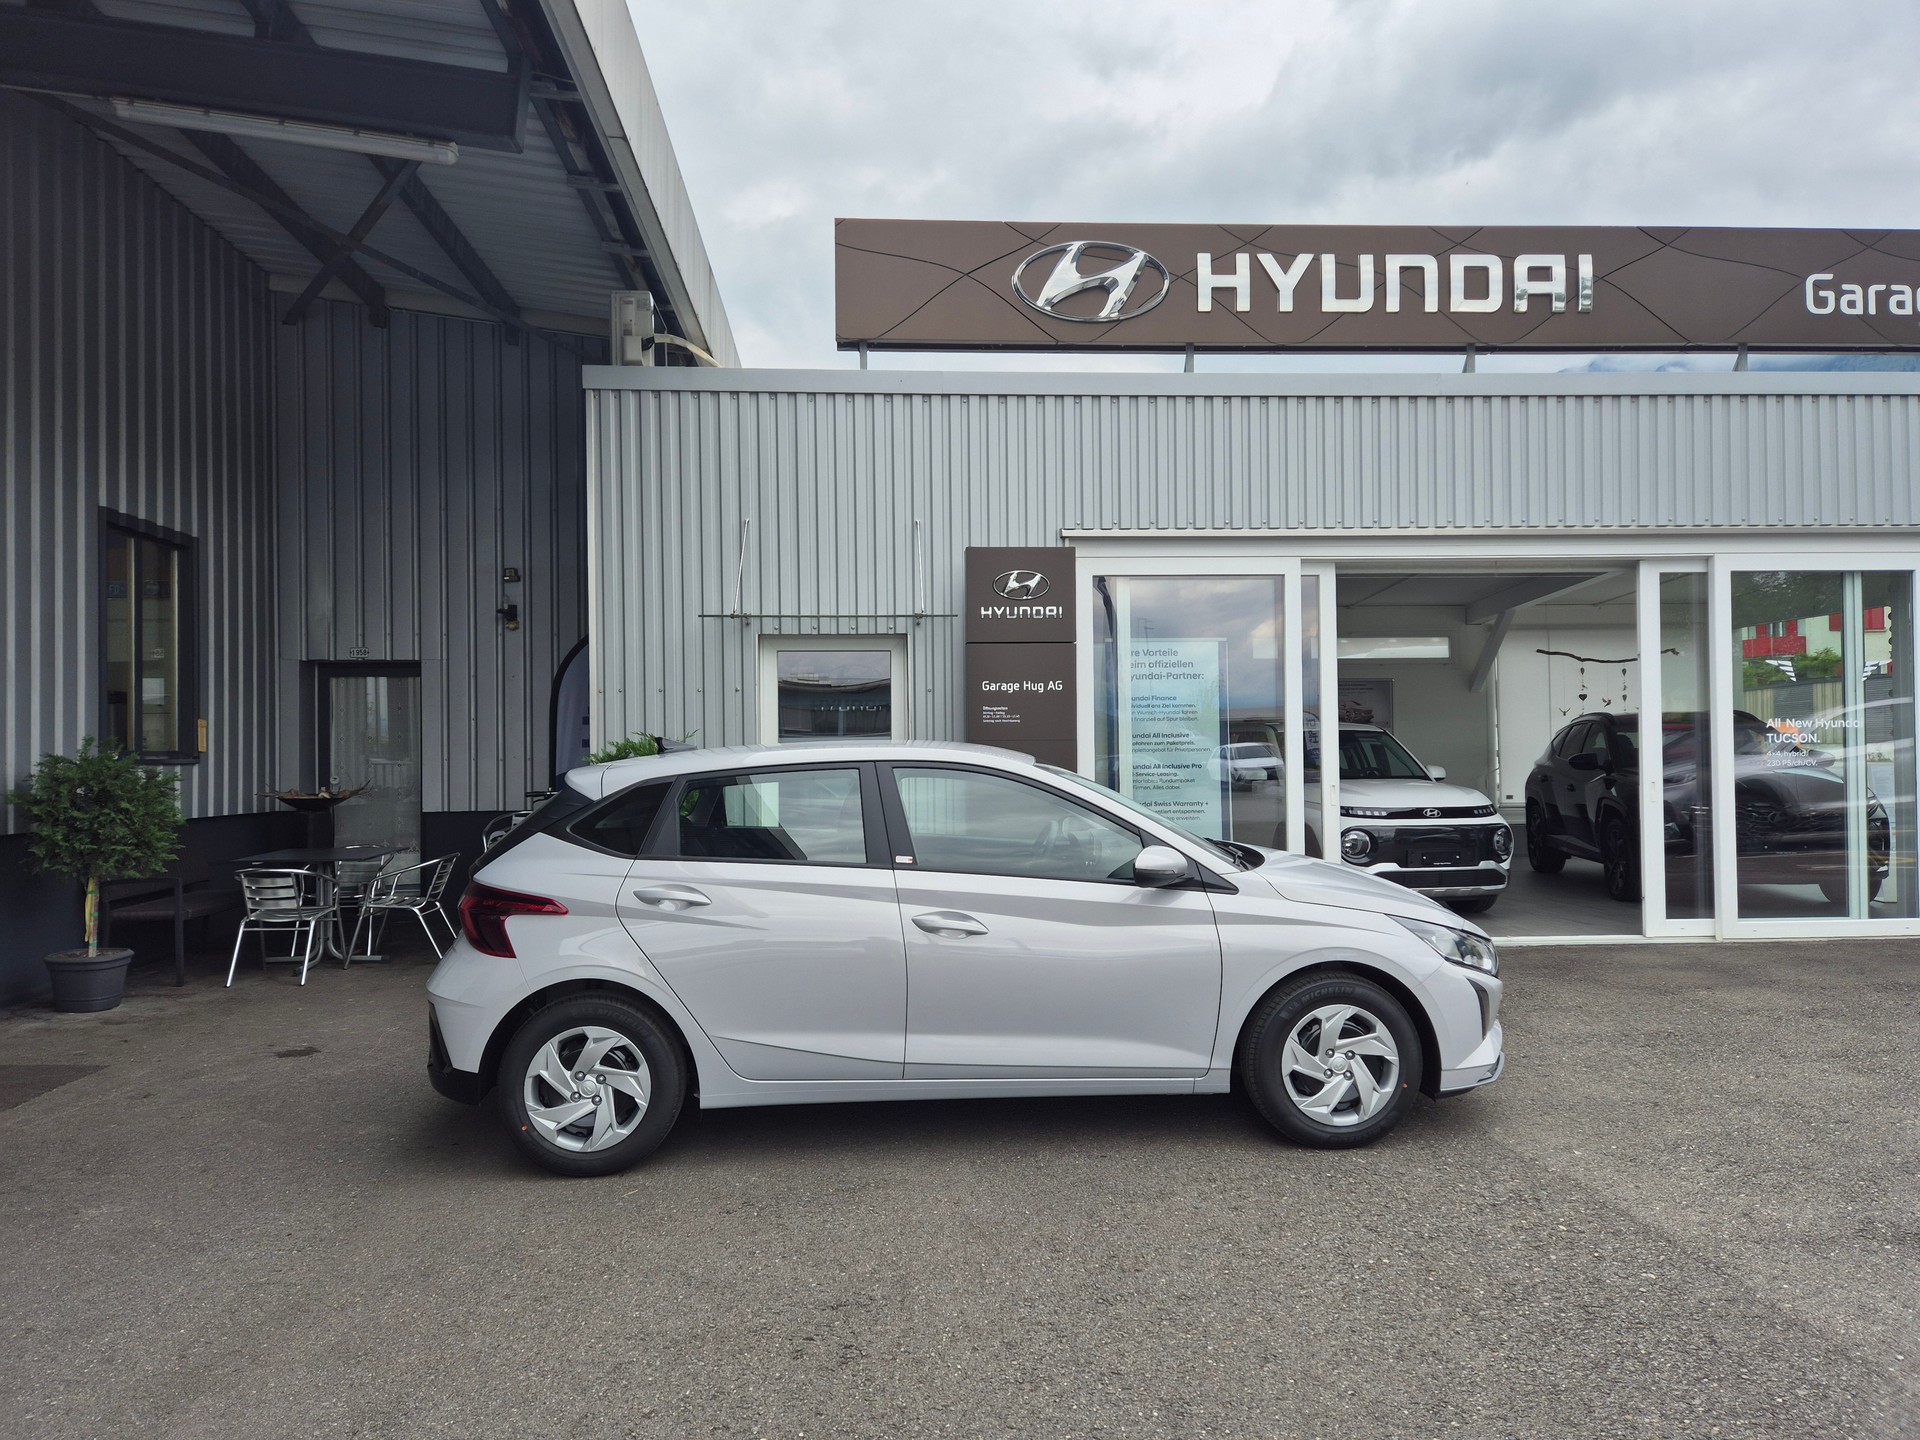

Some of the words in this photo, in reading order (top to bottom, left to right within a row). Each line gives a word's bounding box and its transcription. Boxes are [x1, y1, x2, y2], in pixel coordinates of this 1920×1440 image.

[1197, 253, 1593, 313] HYUNDAI
[1806, 273, 1920, 326] Gara
[981, 606, 1063, 619] HYUNDAI
[1142, 648, 1178, 657] Vorteile
[1130, 660, 1146, 668] eim
[1148, 659, 1194, 669] offiziellen
[1130, 671, 1205, 682] yundai-Partner:
[982, 680, 1020, 693] Garage
[1023, 680, 1044, 693] Hug
[1047, 680, 1063, 691] AG
[1765, 733, 1821, 743] TUCSON.
